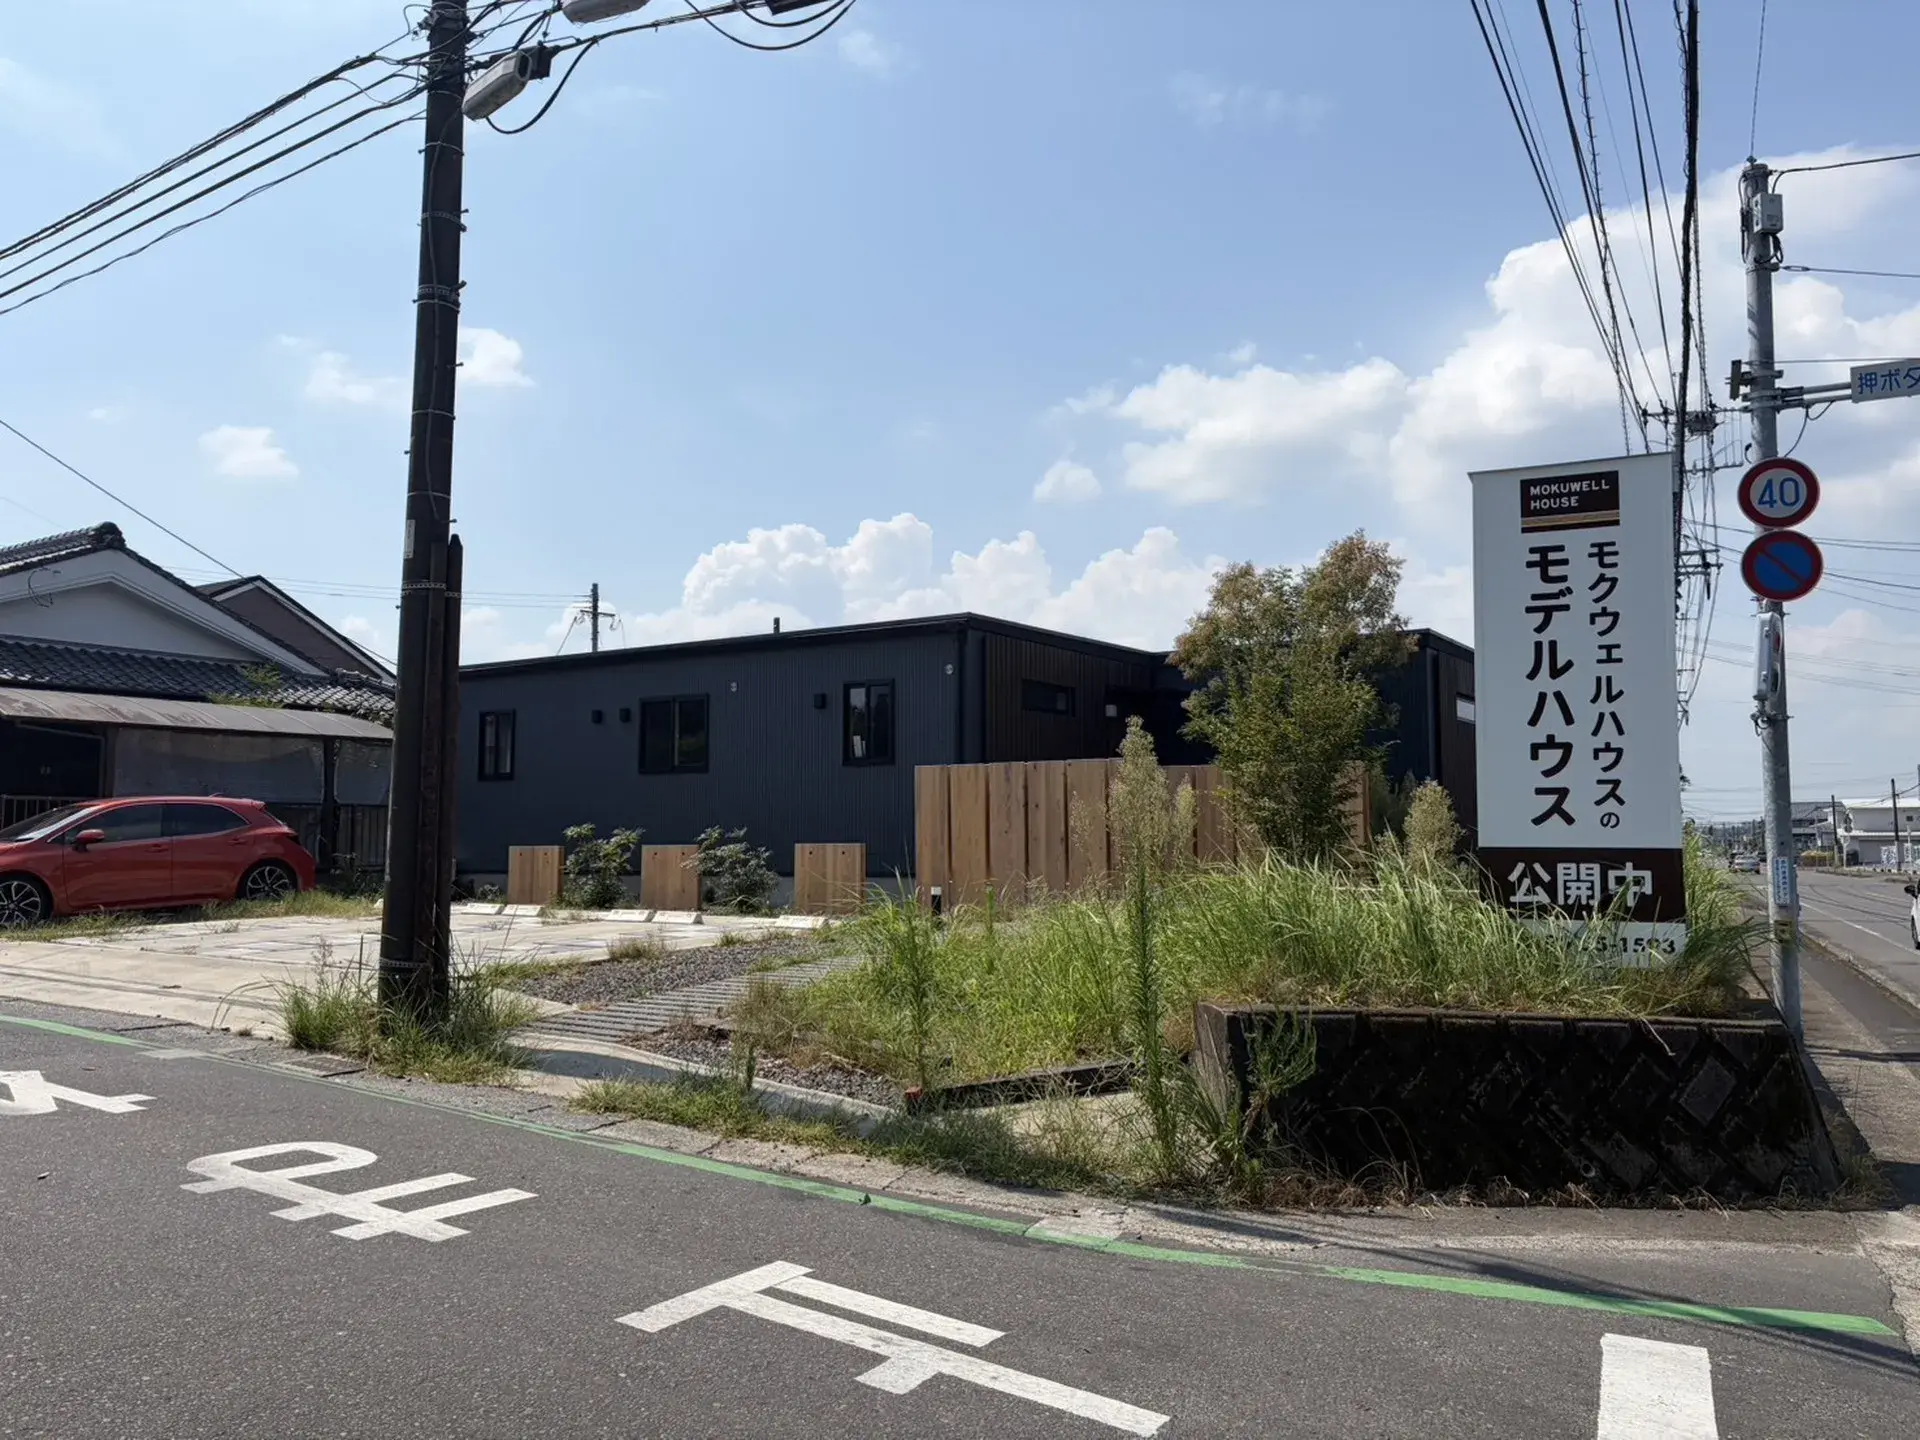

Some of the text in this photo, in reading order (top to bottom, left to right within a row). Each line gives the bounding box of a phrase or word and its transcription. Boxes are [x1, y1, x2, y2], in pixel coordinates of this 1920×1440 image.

[1529, 479, 1611, 497] MOKUWELL
[1529, 495, 1580, 511] HOUSE
[1757, 476, 1800, 508] 40
[1524, 544, 1576, 827] モデルハウス
[1586, 541, 1626, 829] モクウェルハウスの
[1506, 861, 1653, 907] 公開中
